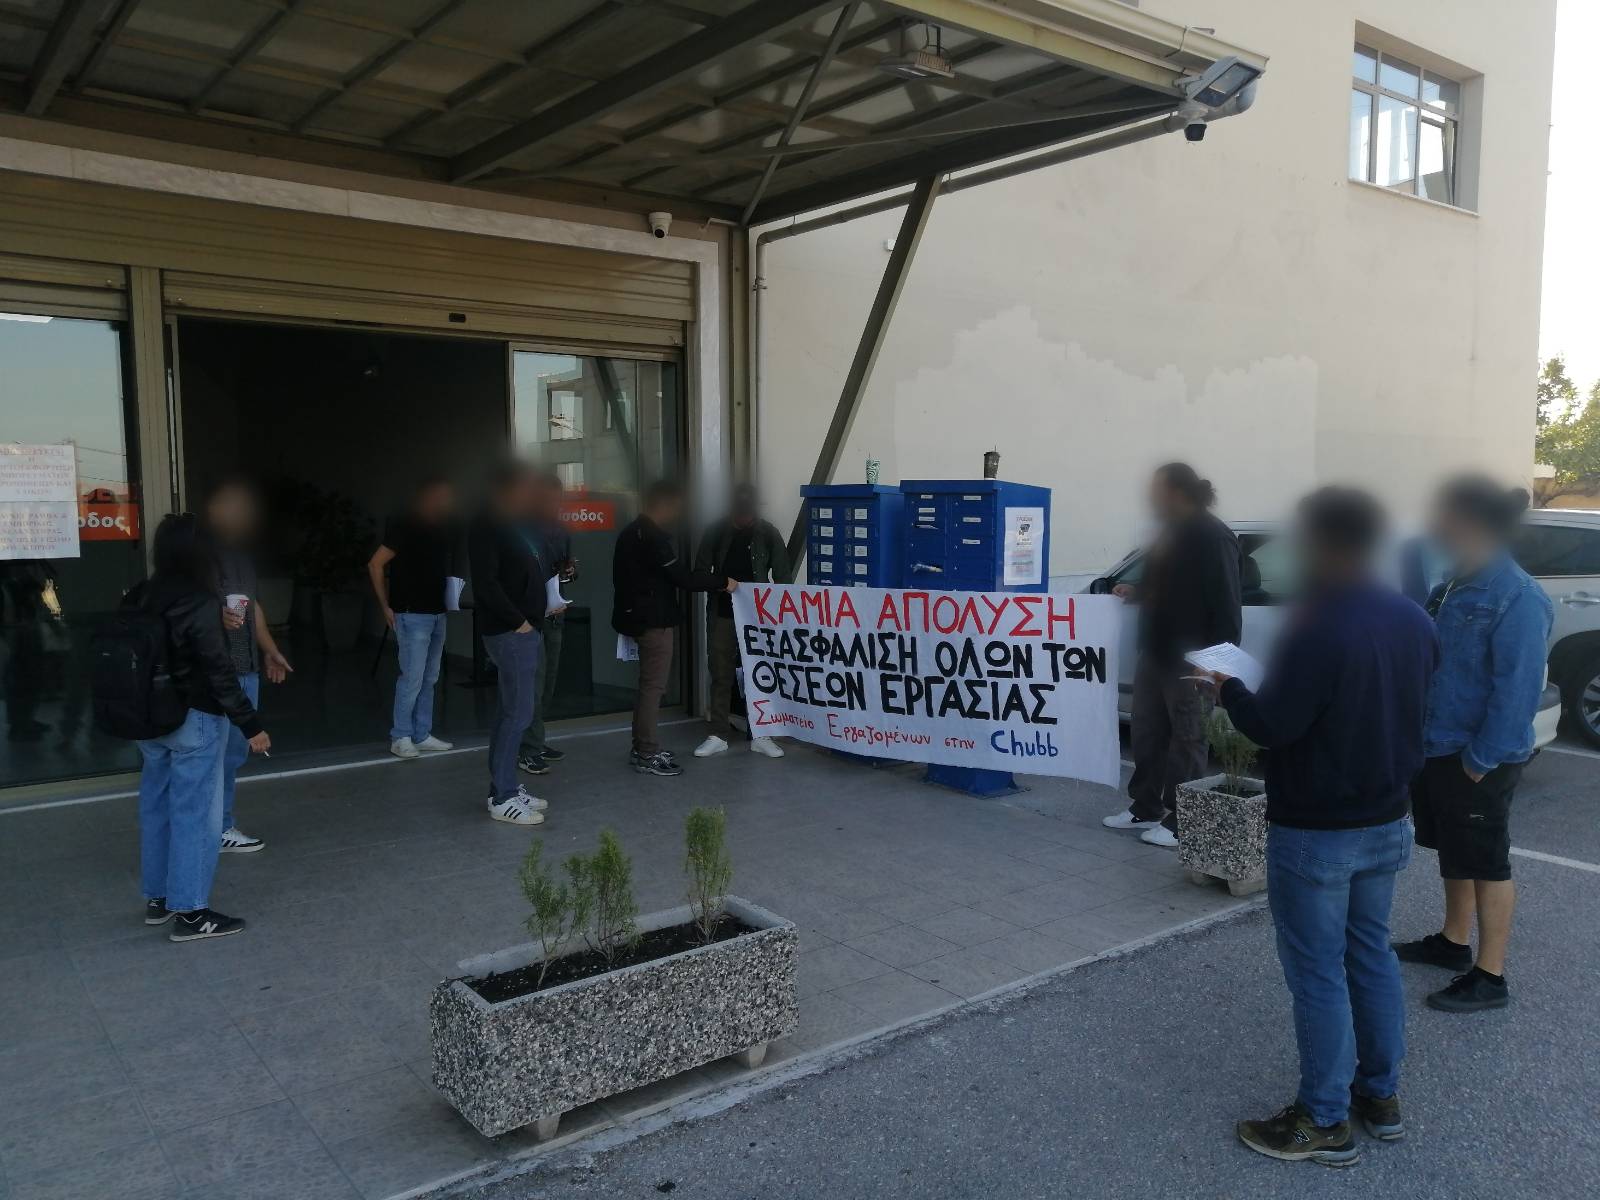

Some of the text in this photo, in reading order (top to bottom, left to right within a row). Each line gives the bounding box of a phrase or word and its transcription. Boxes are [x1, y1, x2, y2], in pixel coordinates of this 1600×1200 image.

[753, 587, 1076, 640] ΚΑΜΙΑ ΑΠΟΛΥΣΗ
[743, 624, 1106, 683] ΕΞΑΣΦΑΛΙΣΗ ΟΛΩΝ ΤΩΝ
[752, 660, 1058, 725] ΘΕΣΕΩΝ ΕΡΓΑΣΙΑΣ
[826, 713, 931, 748] Εργαζομένων
[990, 730, 1059, 758] Chubb
